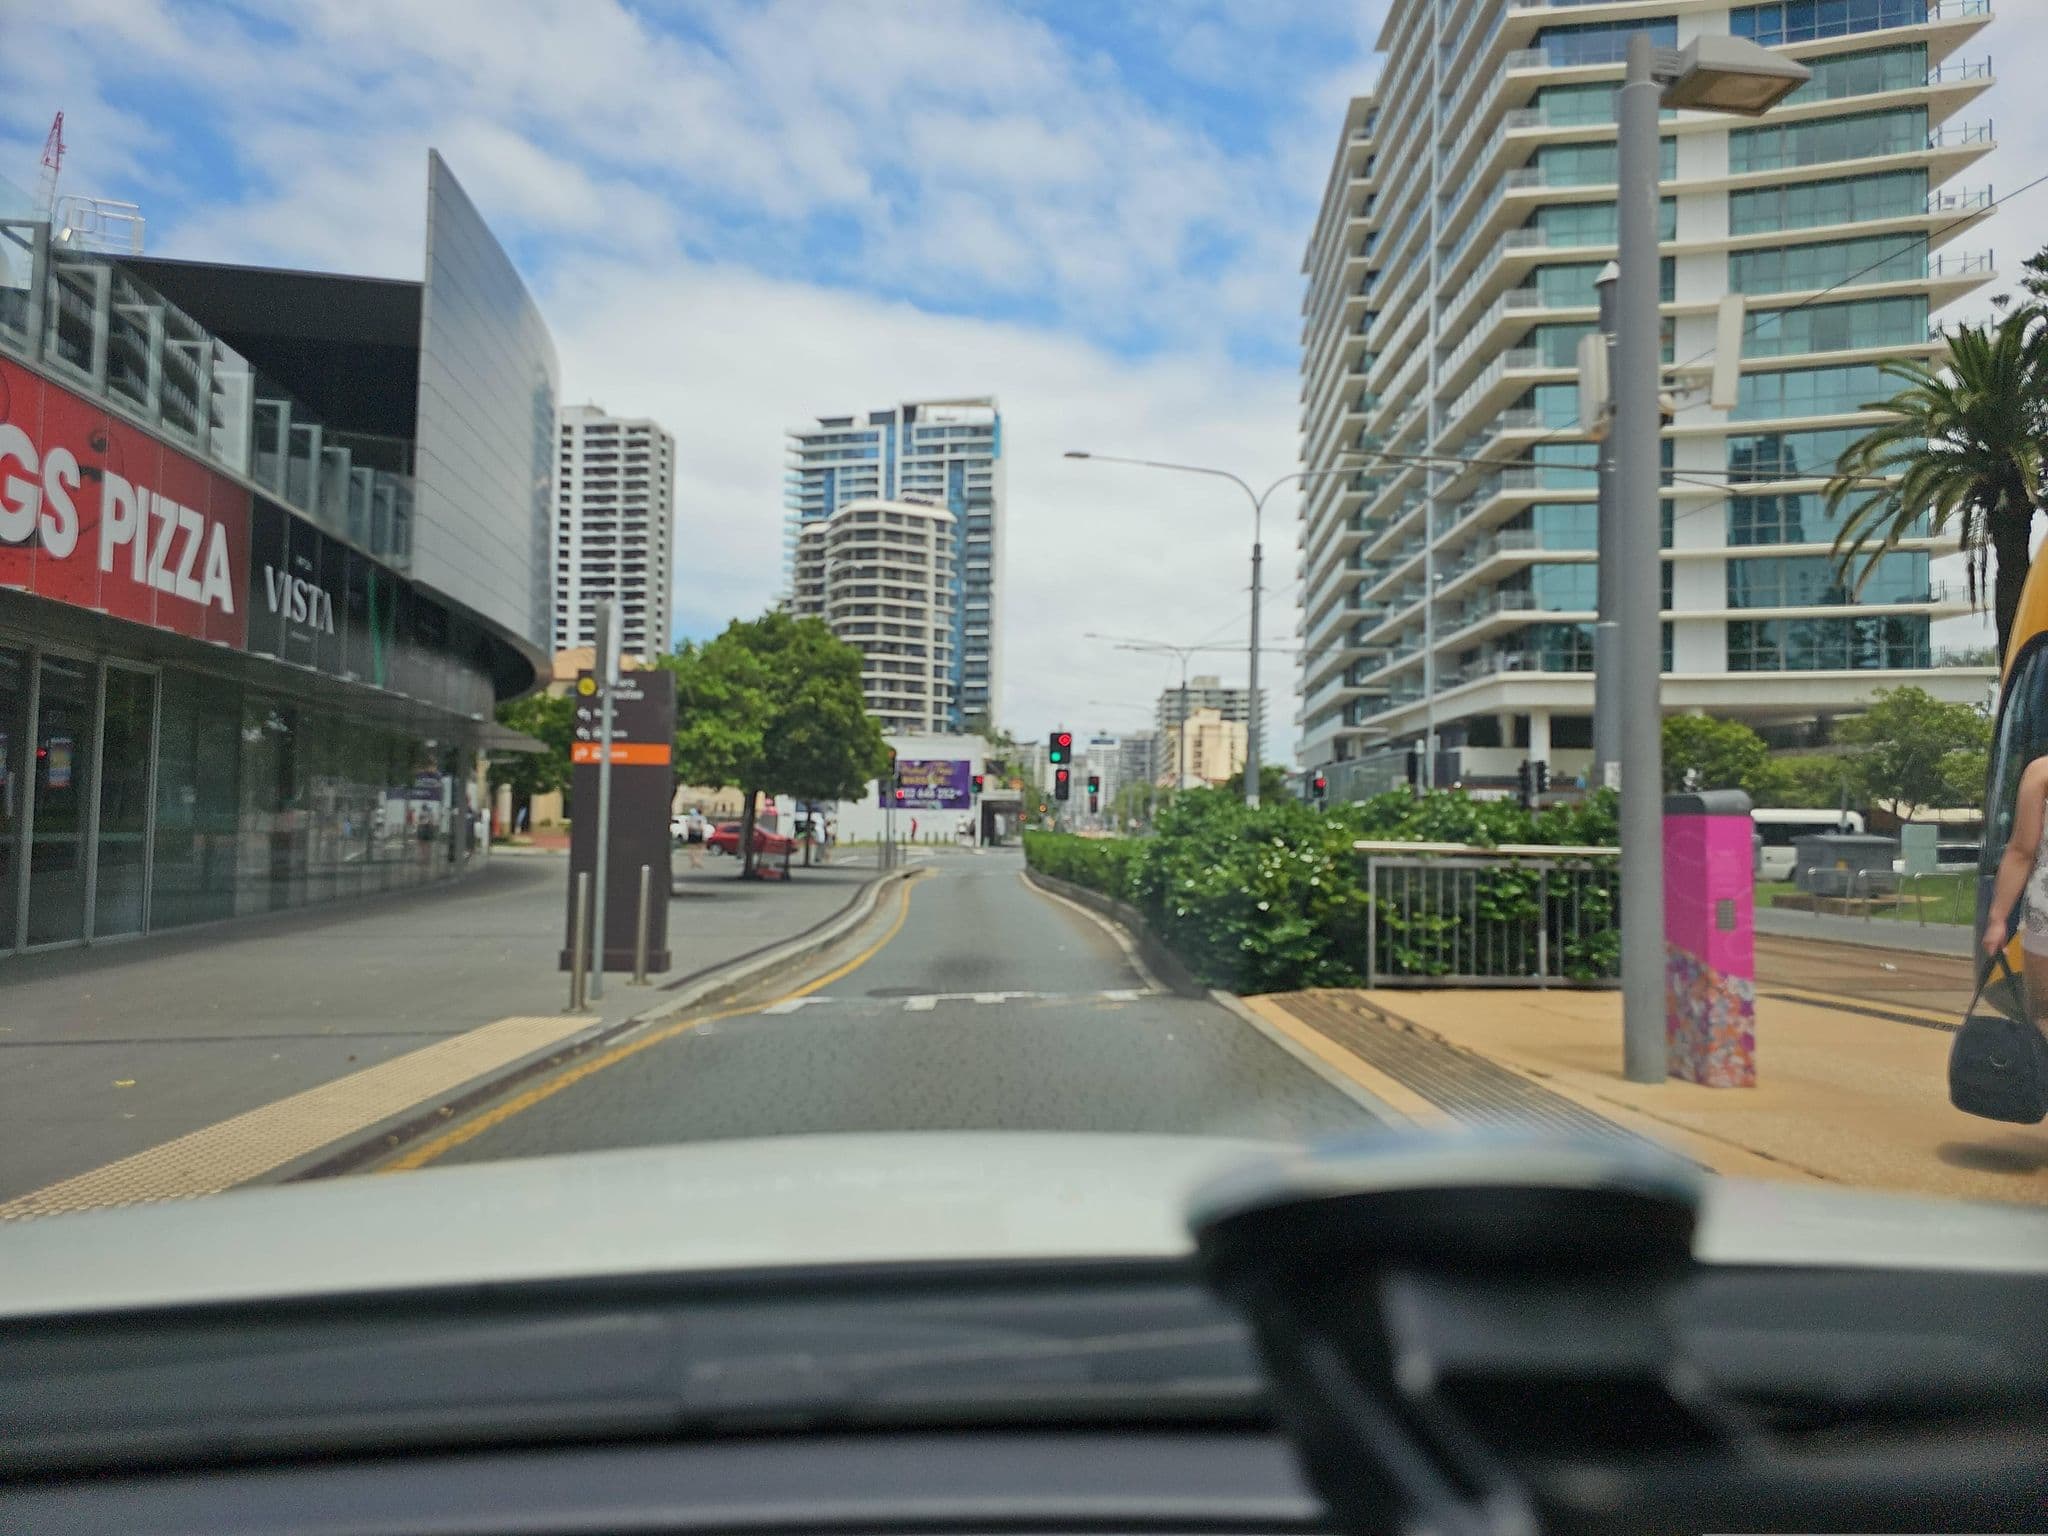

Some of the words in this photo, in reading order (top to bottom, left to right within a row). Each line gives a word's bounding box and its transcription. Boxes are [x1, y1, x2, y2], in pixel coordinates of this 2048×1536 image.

[0, 424, 80, 558] GS
[99, 470, 234, 614] PIZZA
[264, 565, 334, 634] VISTA
